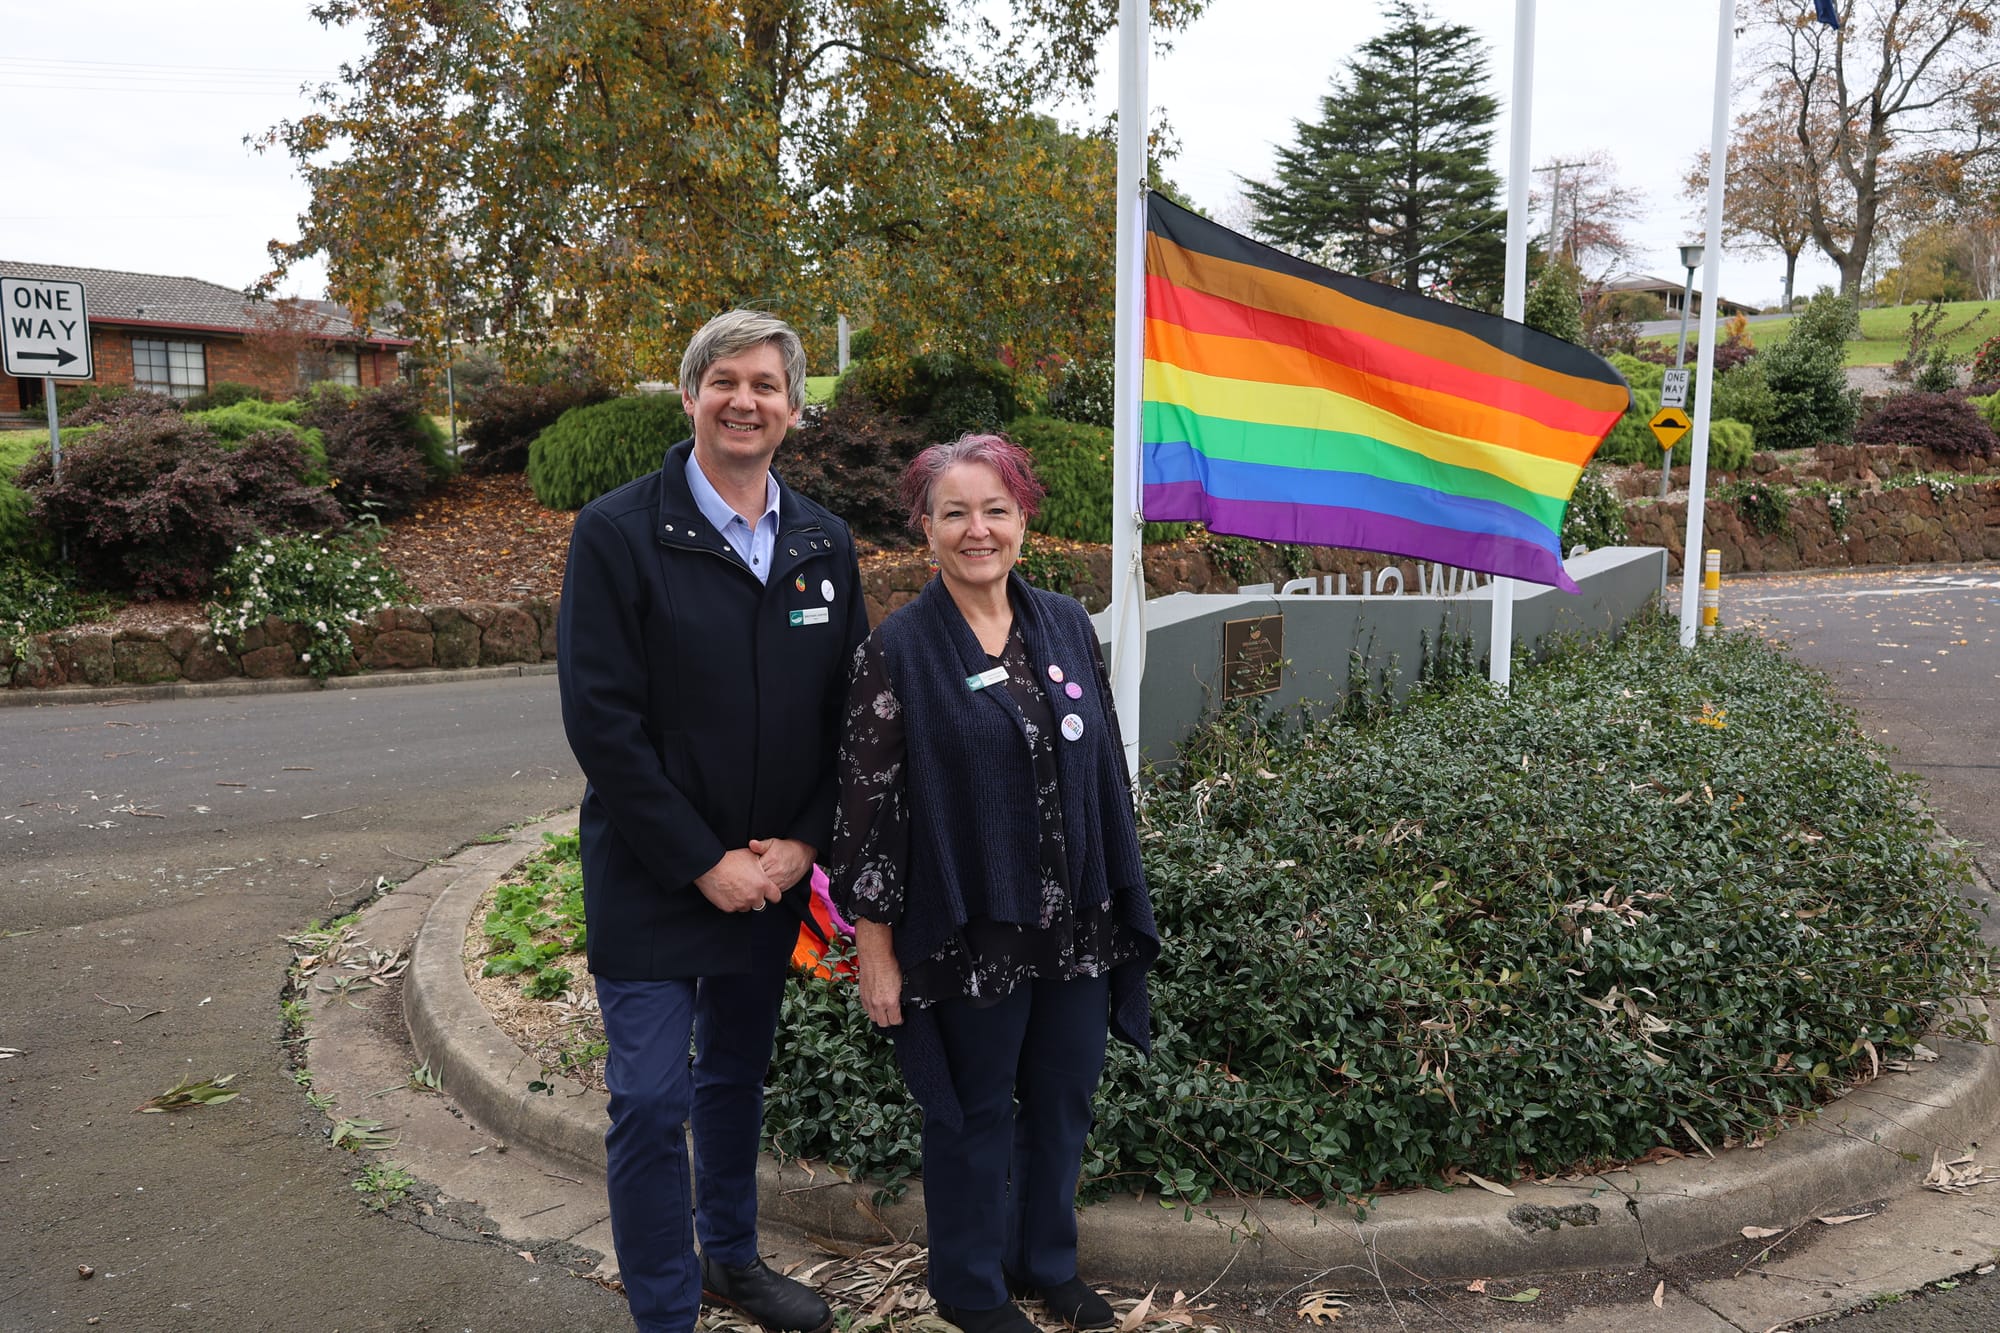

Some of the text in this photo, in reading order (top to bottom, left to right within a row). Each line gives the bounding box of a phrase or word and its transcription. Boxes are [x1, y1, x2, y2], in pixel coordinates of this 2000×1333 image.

[14, 287, 72, 311] ONE
[12, 317, 77, 340] WAY
[1667, 373, 1685, 382] ONE
[1665, 385, 1685, 393] WAY
